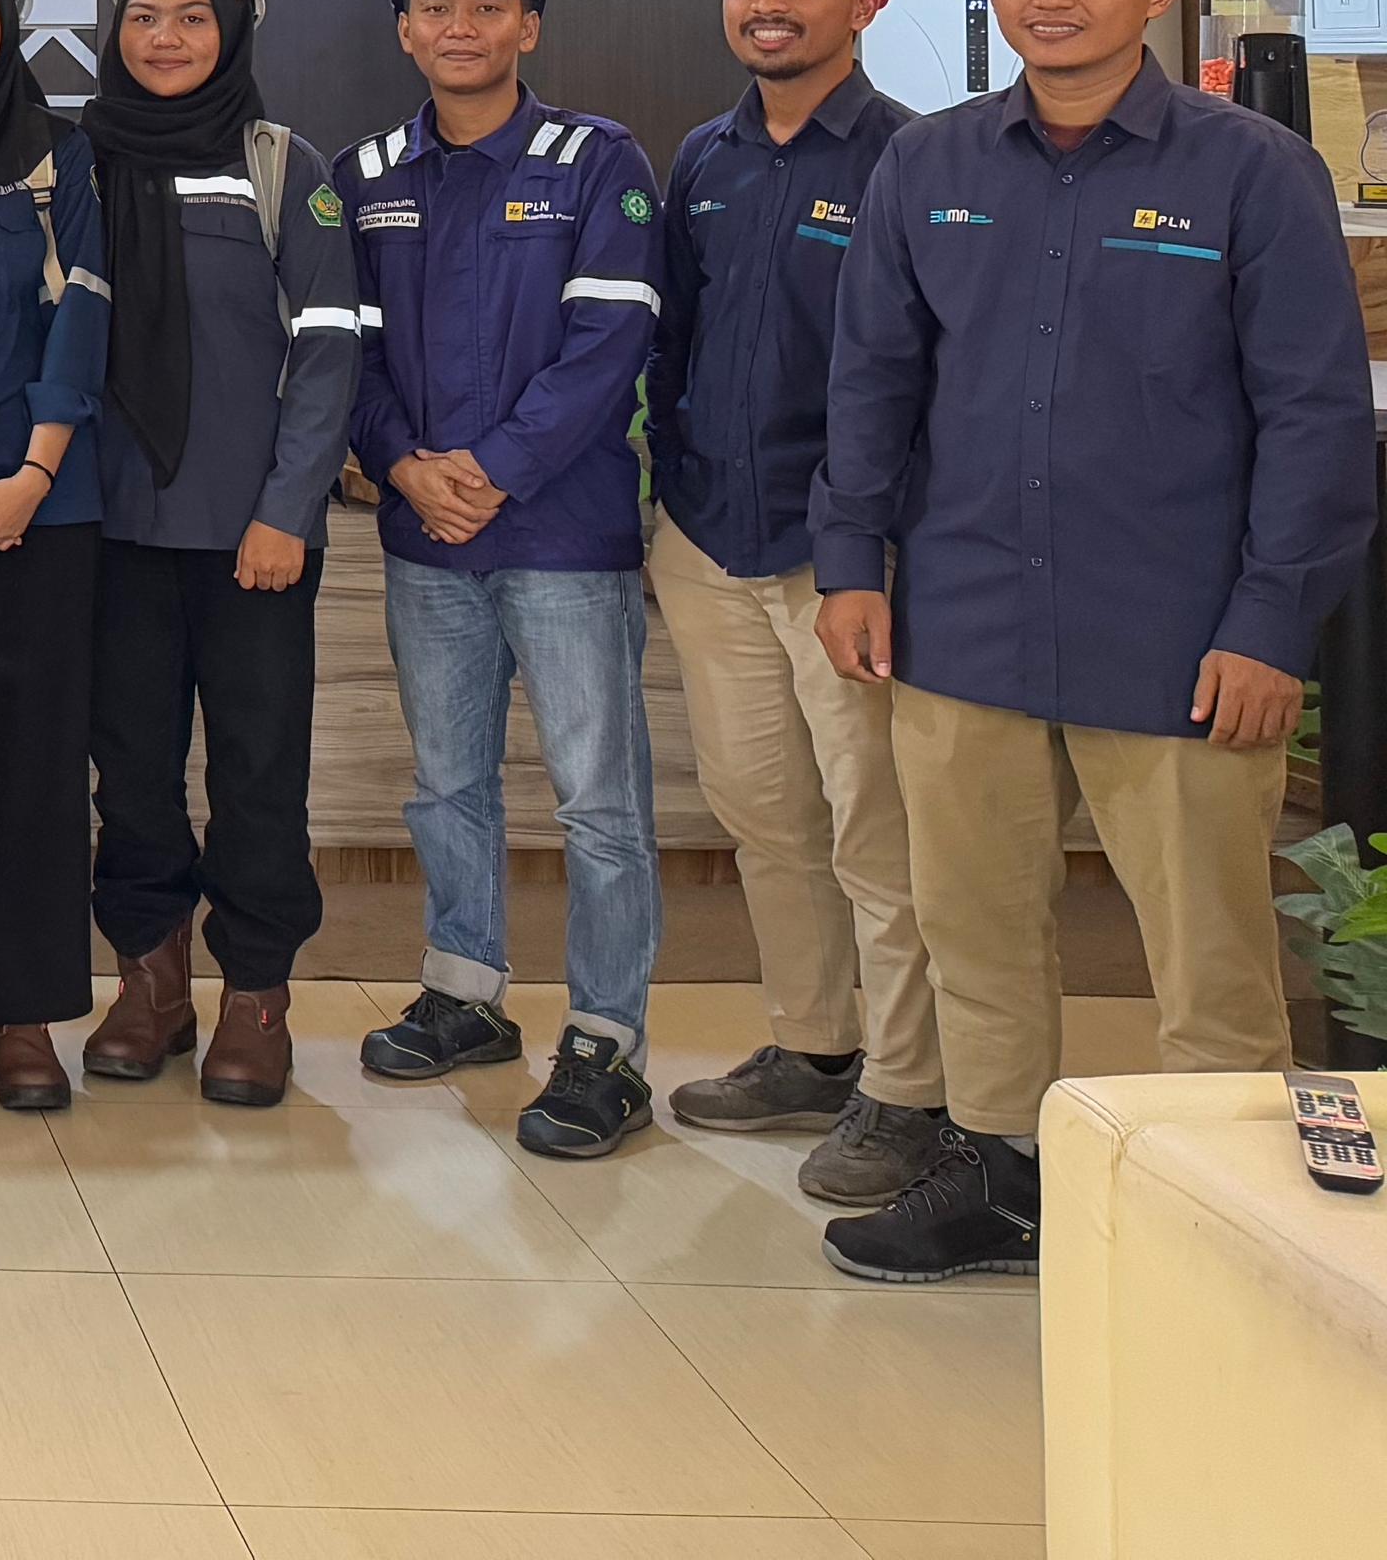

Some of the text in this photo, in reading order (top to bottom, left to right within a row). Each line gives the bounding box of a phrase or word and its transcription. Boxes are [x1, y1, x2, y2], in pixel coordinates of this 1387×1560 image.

[524, 200, 550, 213] PLN
[828, 203, 846, 215] PLN
[1157, 215, 1191, 231] PLN
